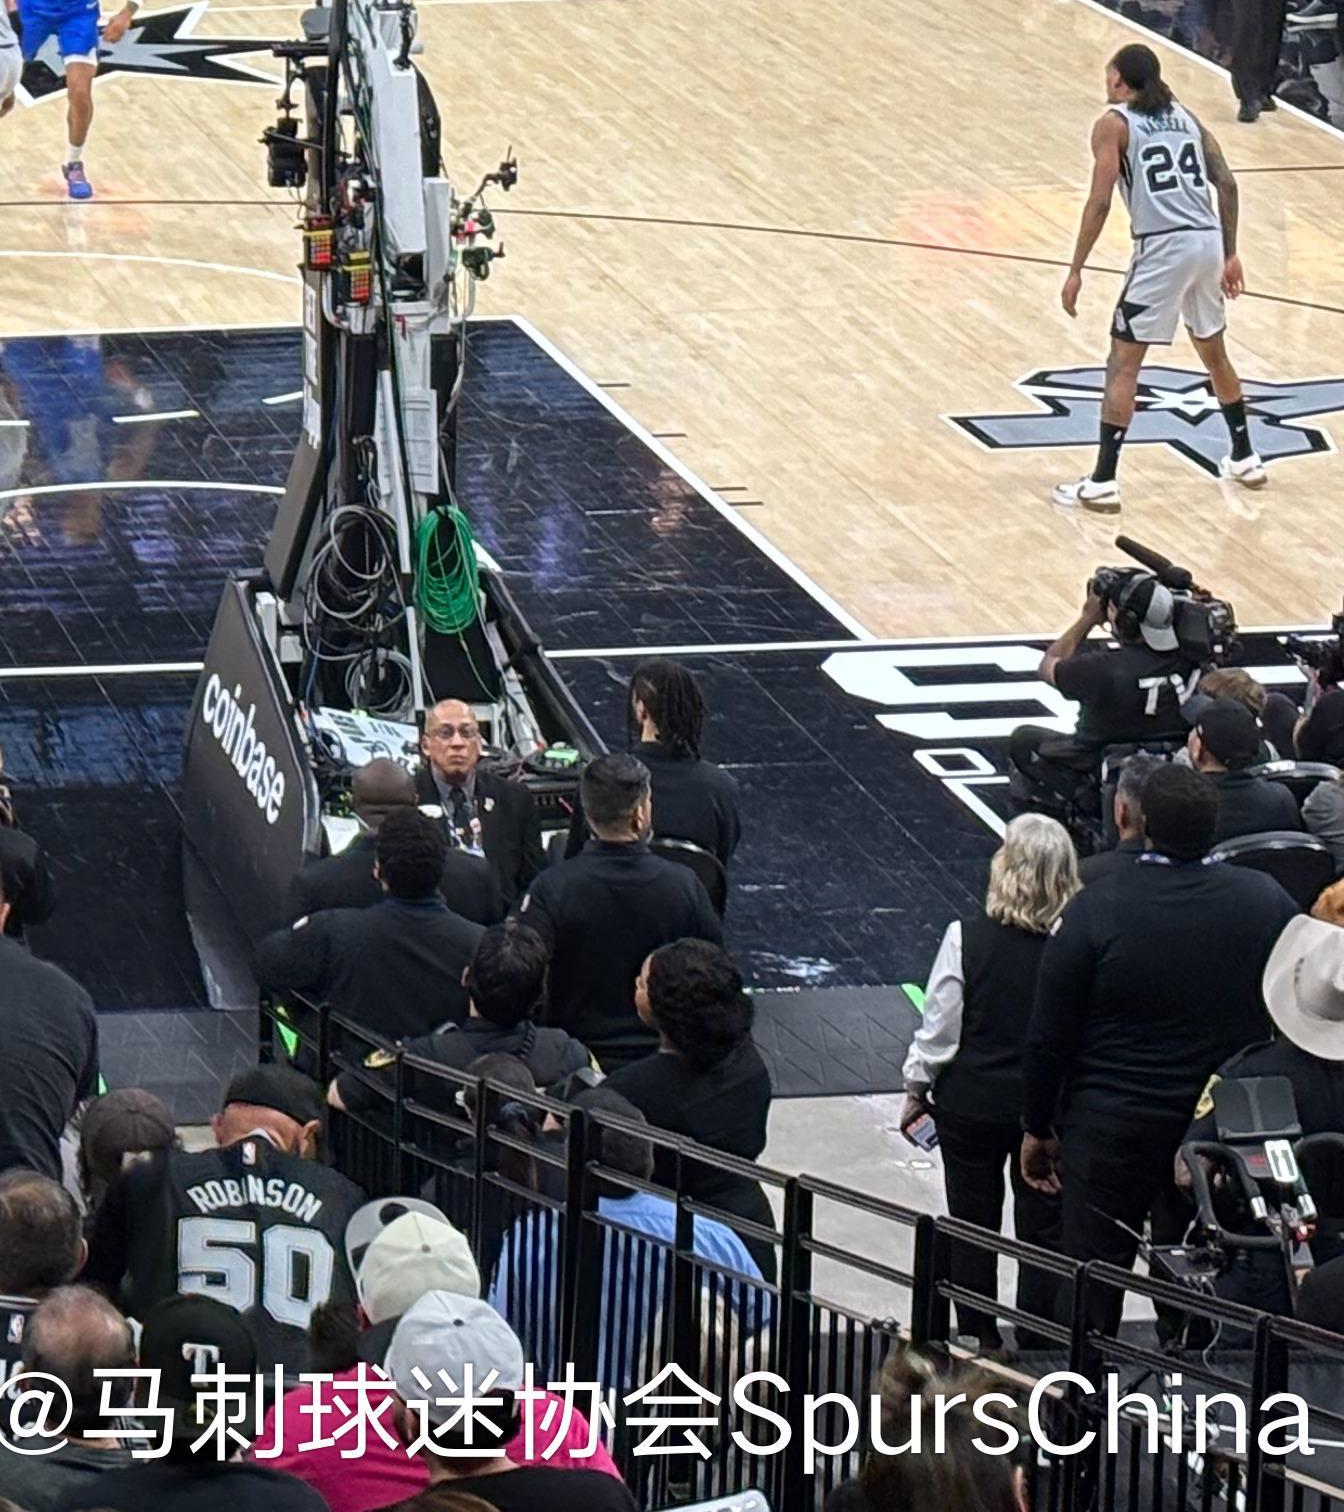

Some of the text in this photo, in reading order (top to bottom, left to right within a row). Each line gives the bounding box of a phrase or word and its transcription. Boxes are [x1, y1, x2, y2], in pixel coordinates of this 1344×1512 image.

[1139, 140, 1206, 196] 24
[203, 673, 285, 825] coinbase
[185, 1173, 323, 1223] ROBINSON
[176, 1215, 335, 1331] 50
